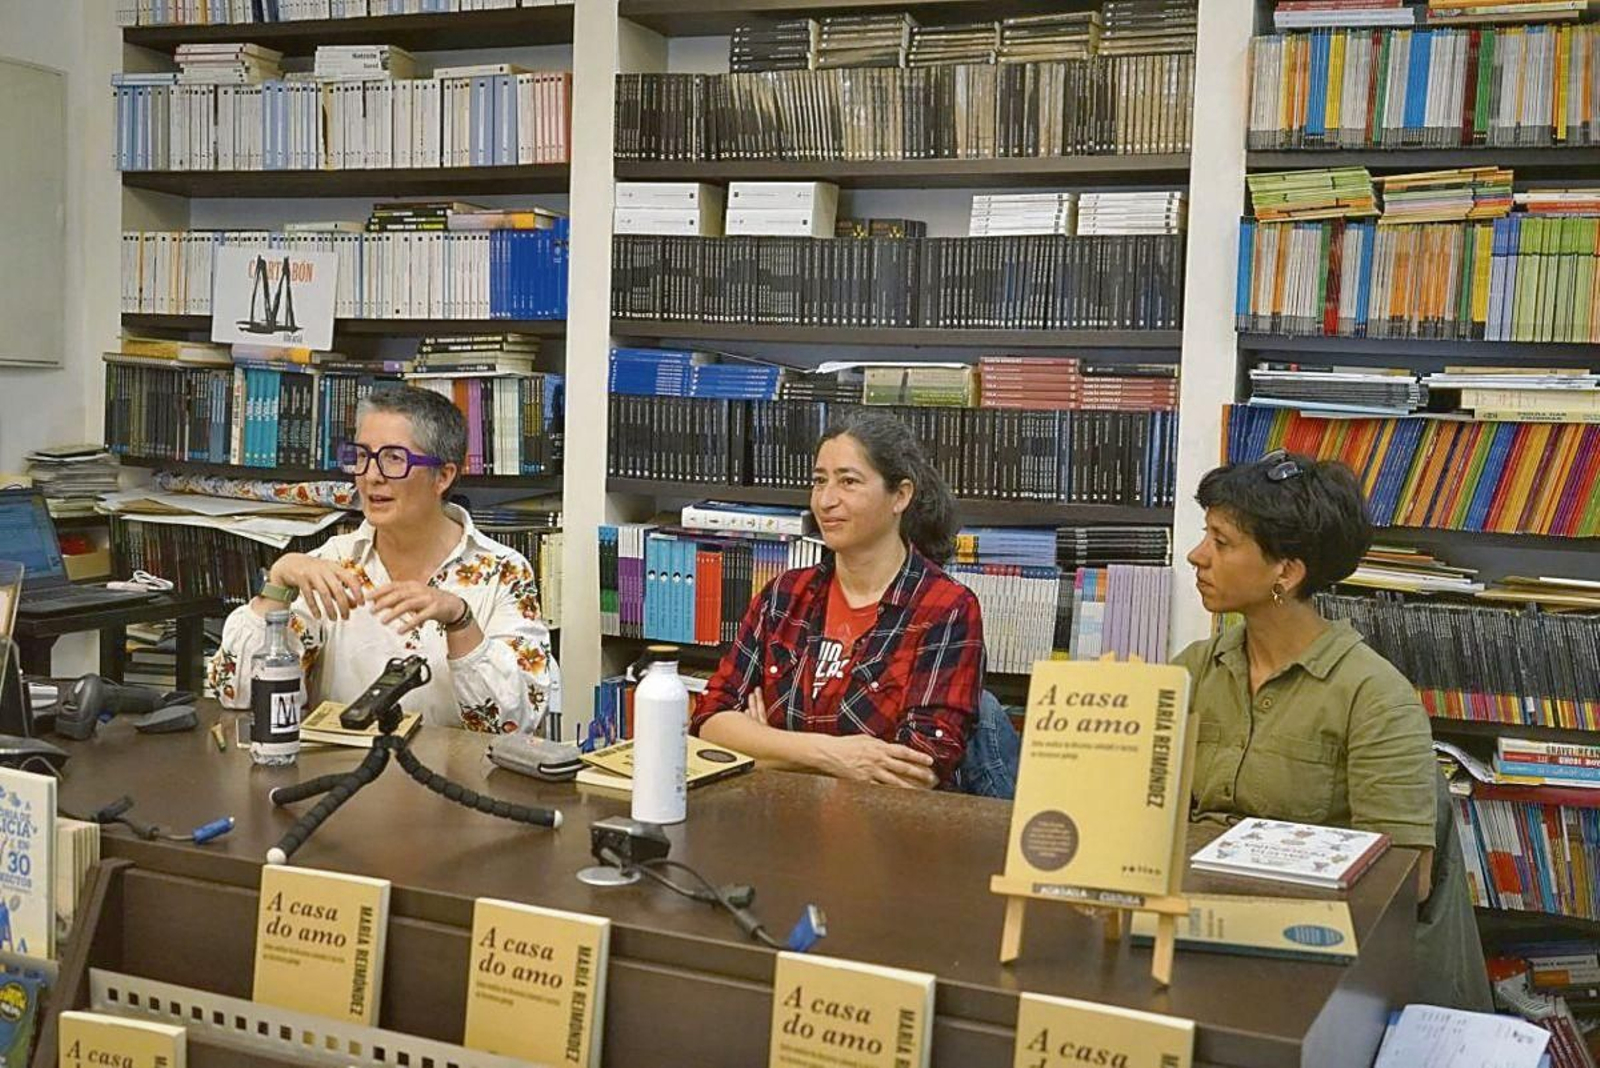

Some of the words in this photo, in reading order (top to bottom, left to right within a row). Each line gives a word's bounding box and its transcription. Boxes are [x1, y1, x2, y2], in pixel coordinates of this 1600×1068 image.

[248, 260, 313, 283] CRTBÓN
[1037, 684, 1057, 706] A
[1065, 691, 1129, 708] casa
[1154, 689, 1176, 731] MARÍA
[1035, 709, 1069, 732] do
[1076, 717, 1141, 736] amo
[0, 818, 31, 838] ICIA
[8, 851, 31, 876] 30
[266, 891, 283, 913] A
[289, 902, 338, 921] casa
[265, 916, 292, 938] do
[298, 928, 346, 948] amo
[479, 926, 496, 949] A
[503, 939, 554, 960] casa
[478, 952, 506, 975] do
[512, 966, 563, 989] amo
[783, 985, 802, 1008] A
[811, 999, 871, 1024] casa
[783, 1013, 814, 1039] do
[822, 1029, 882, 1055] amo
[1027, 1028, 1049, 1051] A
[1059, 1041, 1129, 1068] casa
[66, 1039, 81, 1059] A
[88, 1050, 134, 1068] casa
